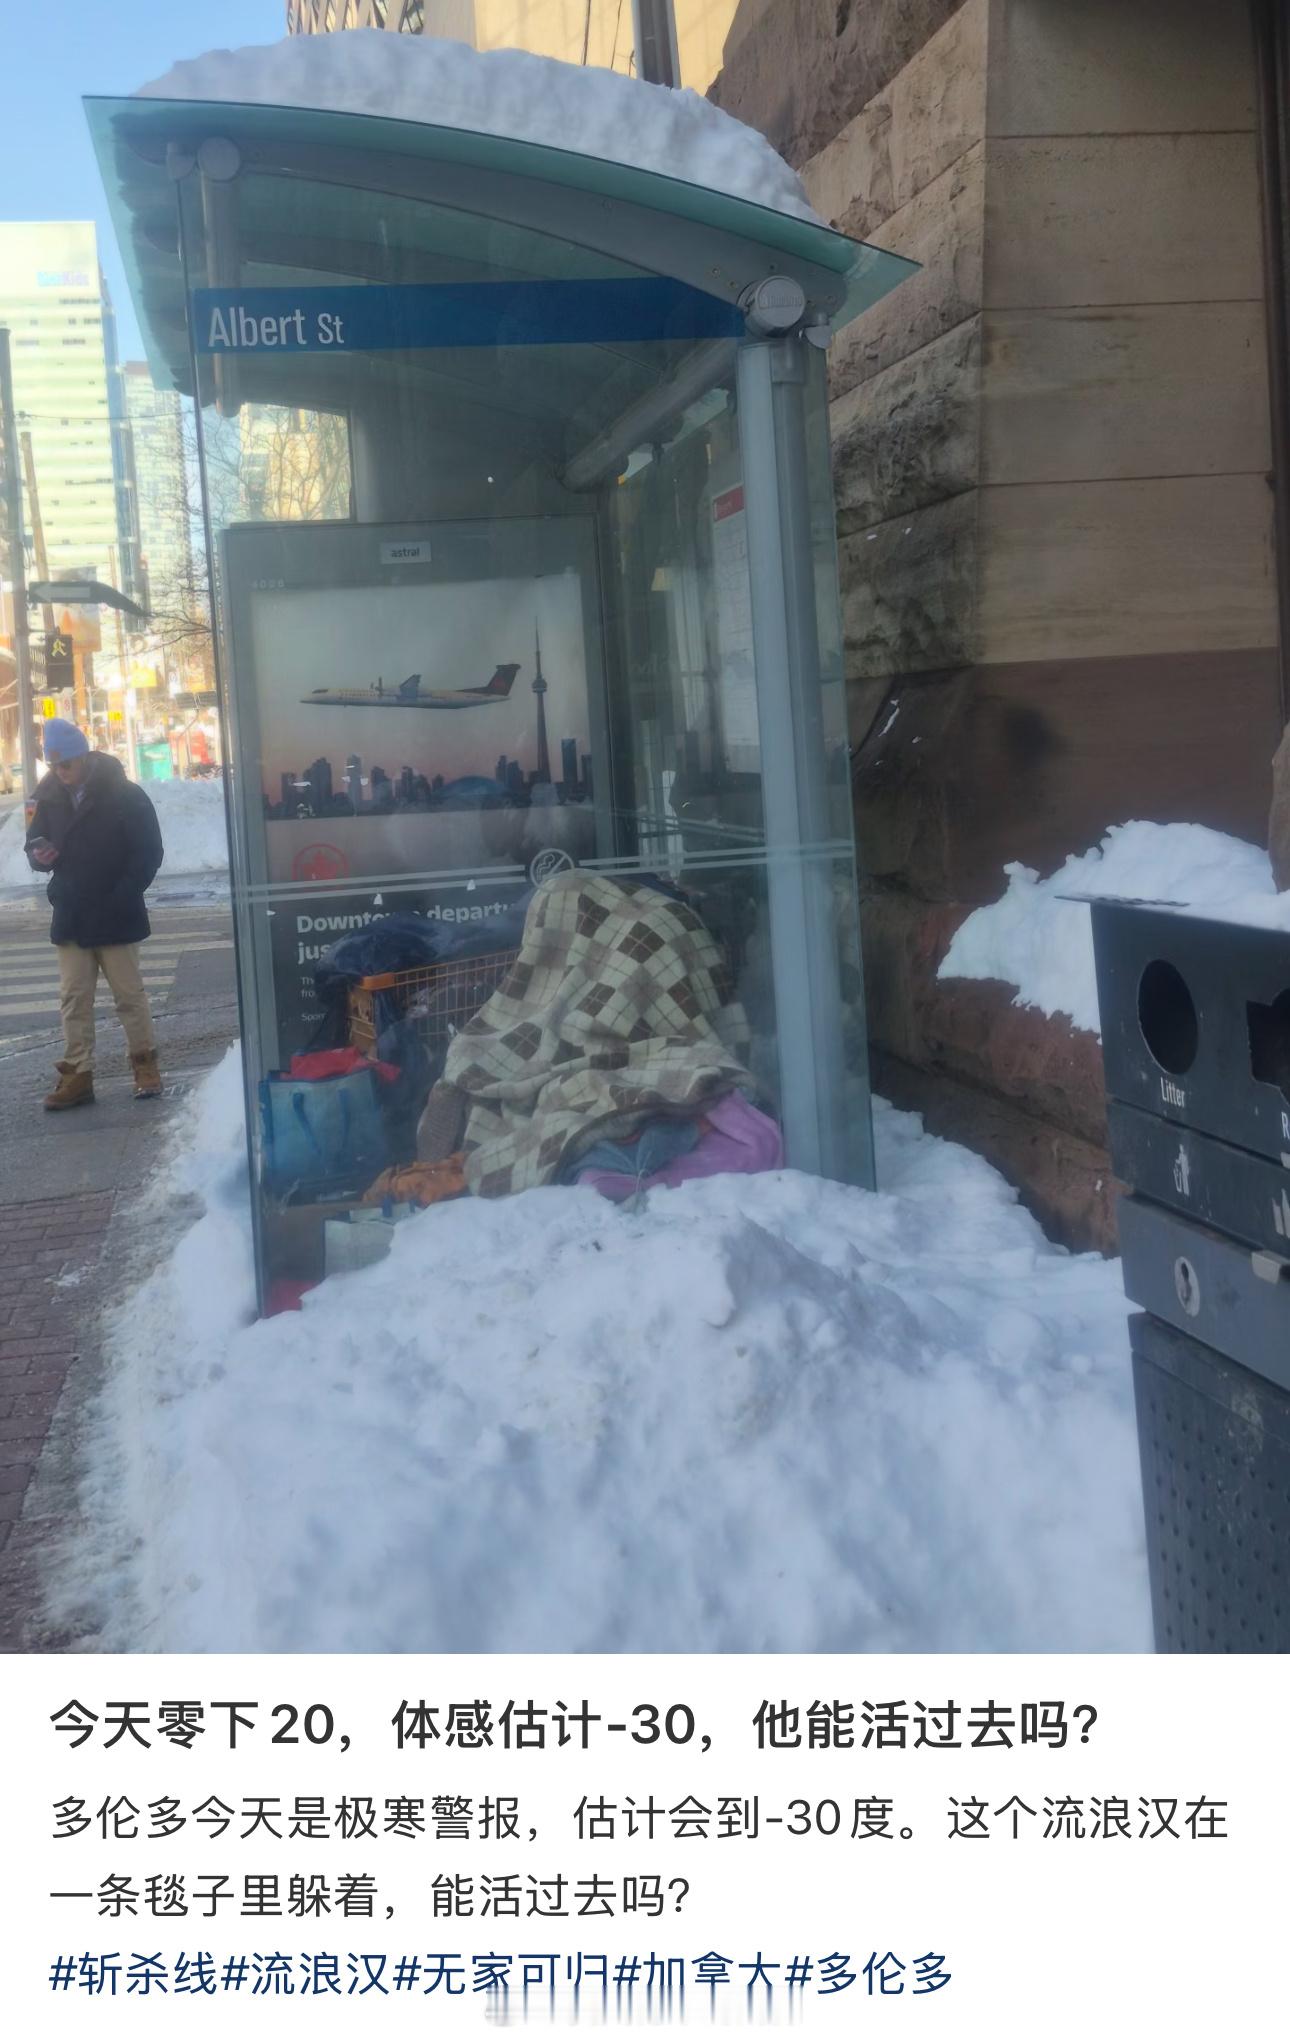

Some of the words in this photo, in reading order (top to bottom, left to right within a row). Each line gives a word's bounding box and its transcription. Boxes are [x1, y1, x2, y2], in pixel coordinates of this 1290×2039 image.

[208, 307, 307, 348] Albert
[317, 312, 345, 345] St
[391, 547, 420, 558] astral
[1160, 1077, 1185, 1108] Litter
